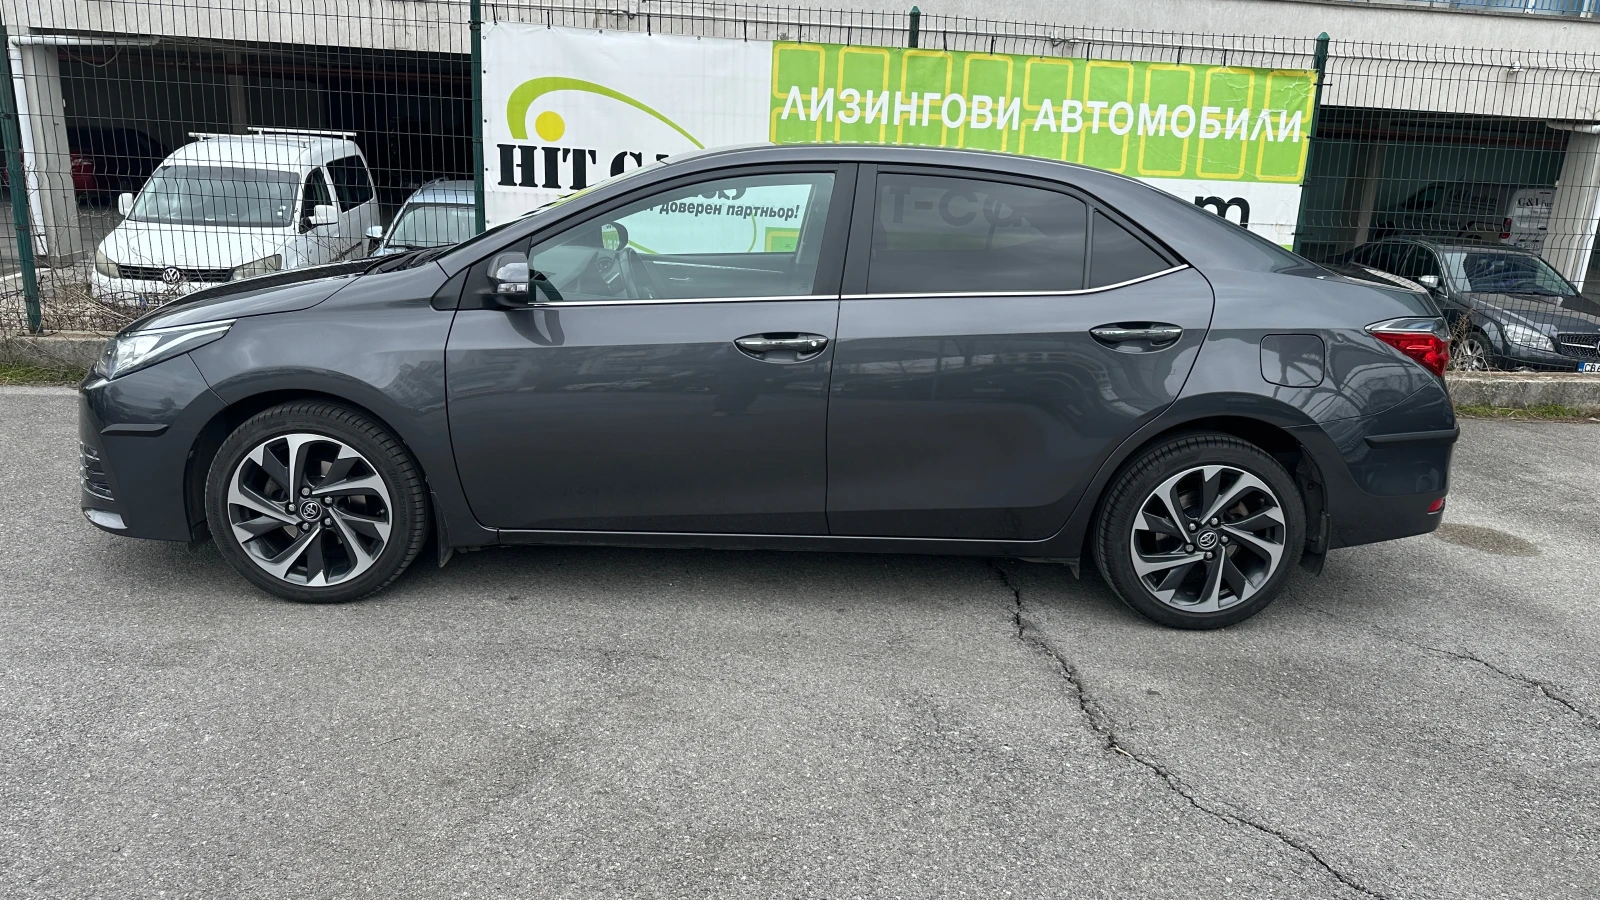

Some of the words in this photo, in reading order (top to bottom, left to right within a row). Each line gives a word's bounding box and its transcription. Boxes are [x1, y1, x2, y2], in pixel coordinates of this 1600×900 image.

[781, 85, 1022, 131] ЛИЗИНГОВИ
[1033, 97, 1303, 143] АВТОМОБИЛИ
[497, 143, 597, 190] HIT
[659, 201, 723, 217] доверен
[726, 203, 800, 222] партньор!
[1518, 197, 1539, 207] G&I
